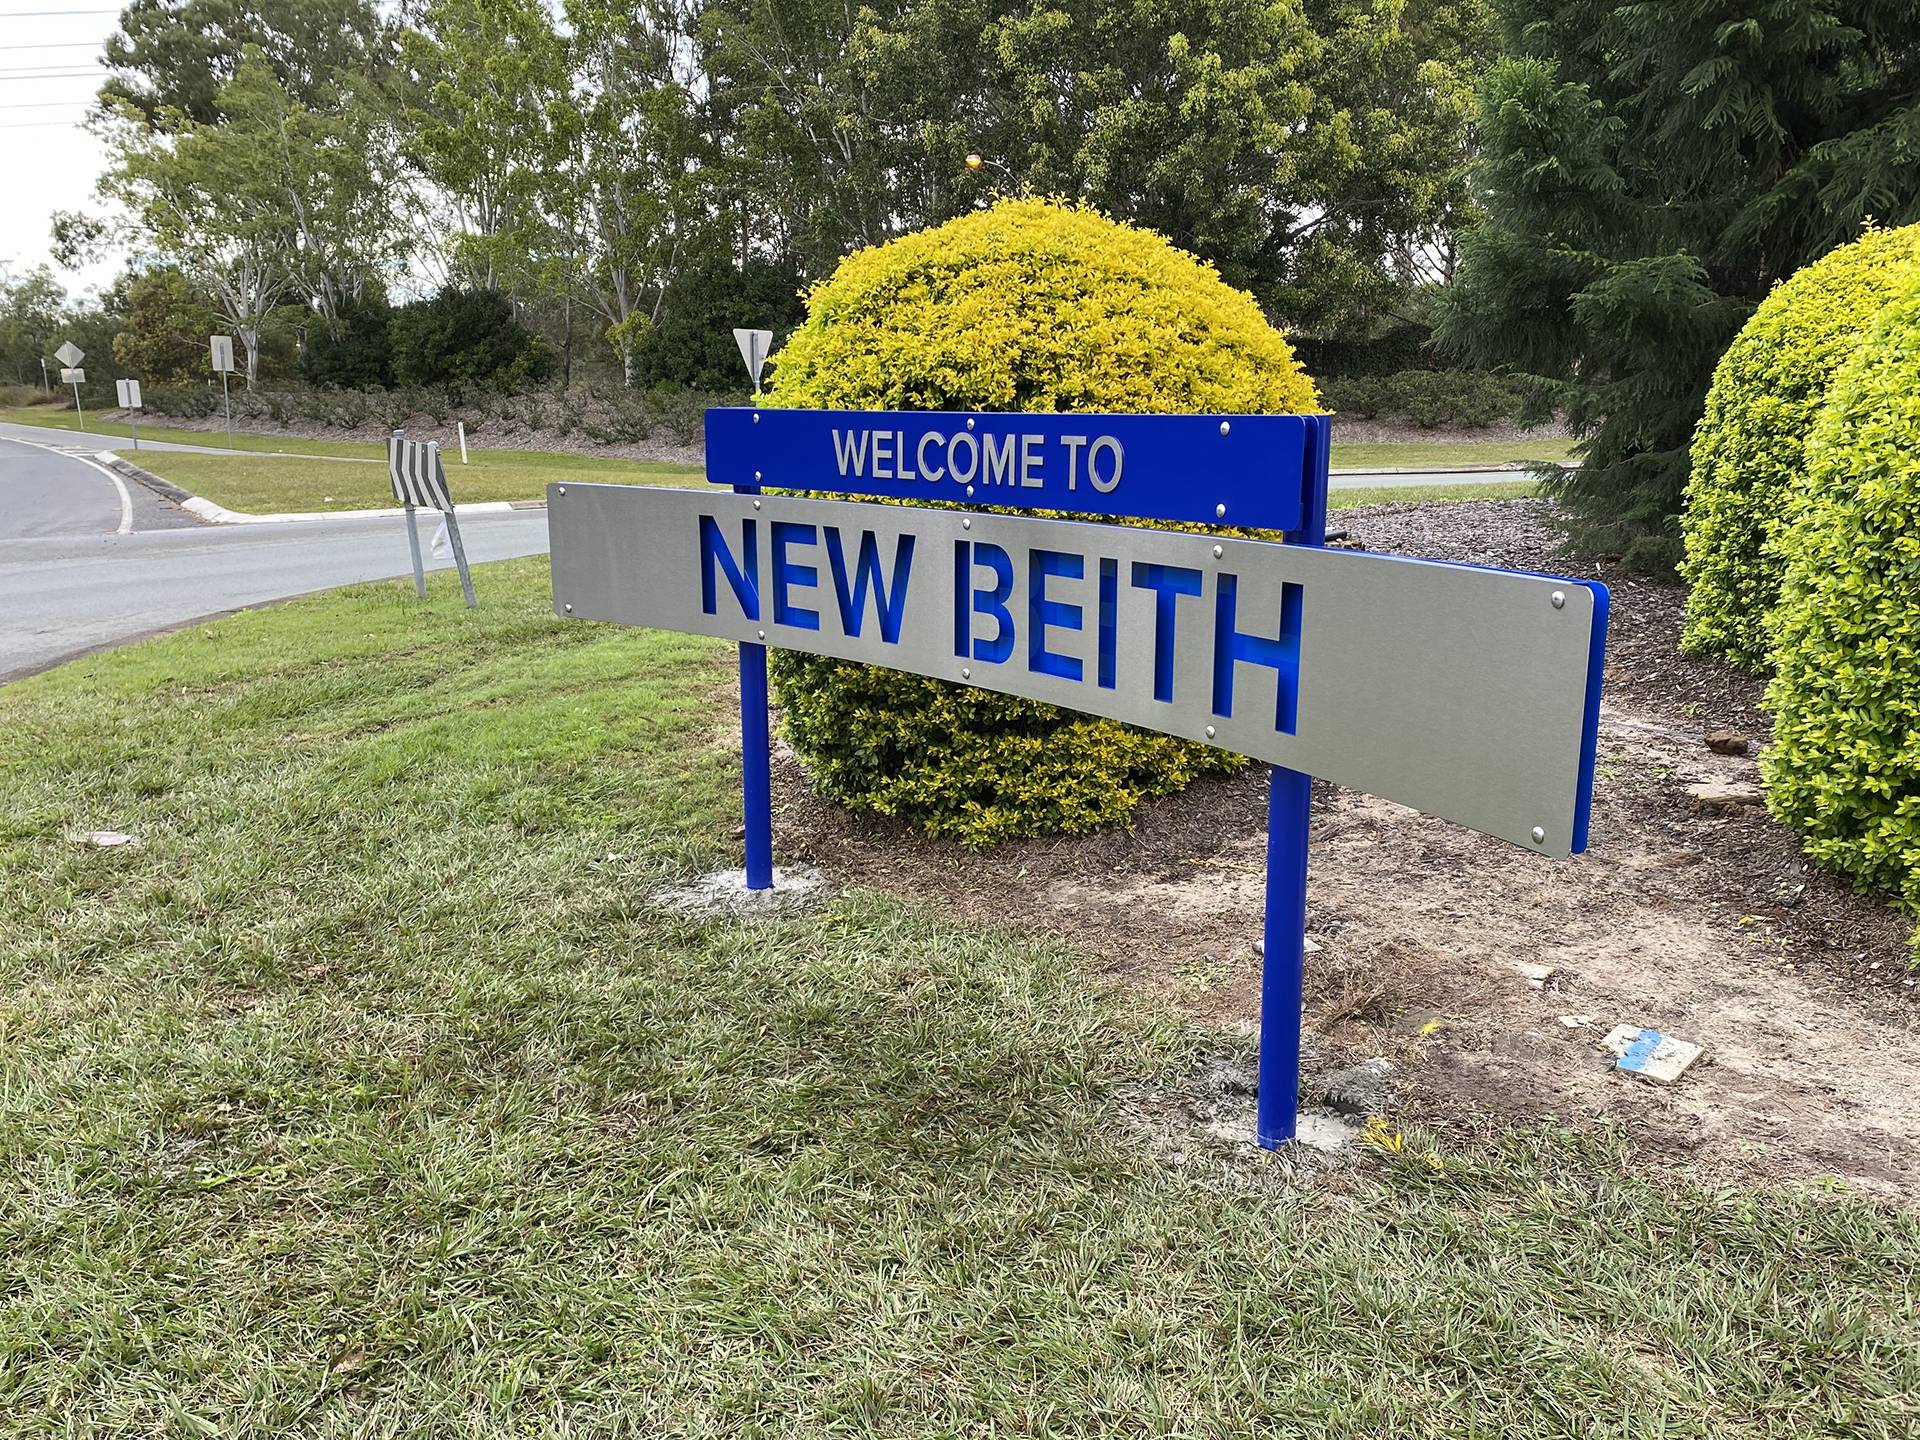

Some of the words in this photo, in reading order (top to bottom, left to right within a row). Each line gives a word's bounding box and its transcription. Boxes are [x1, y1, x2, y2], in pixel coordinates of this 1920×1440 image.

[832, 428, 1045, 489] WELCOME
[1060, 434, 1125, 494] TO
[699, 514, 916, 645] NEW
[953, 539, 1304, 736] BEITH
